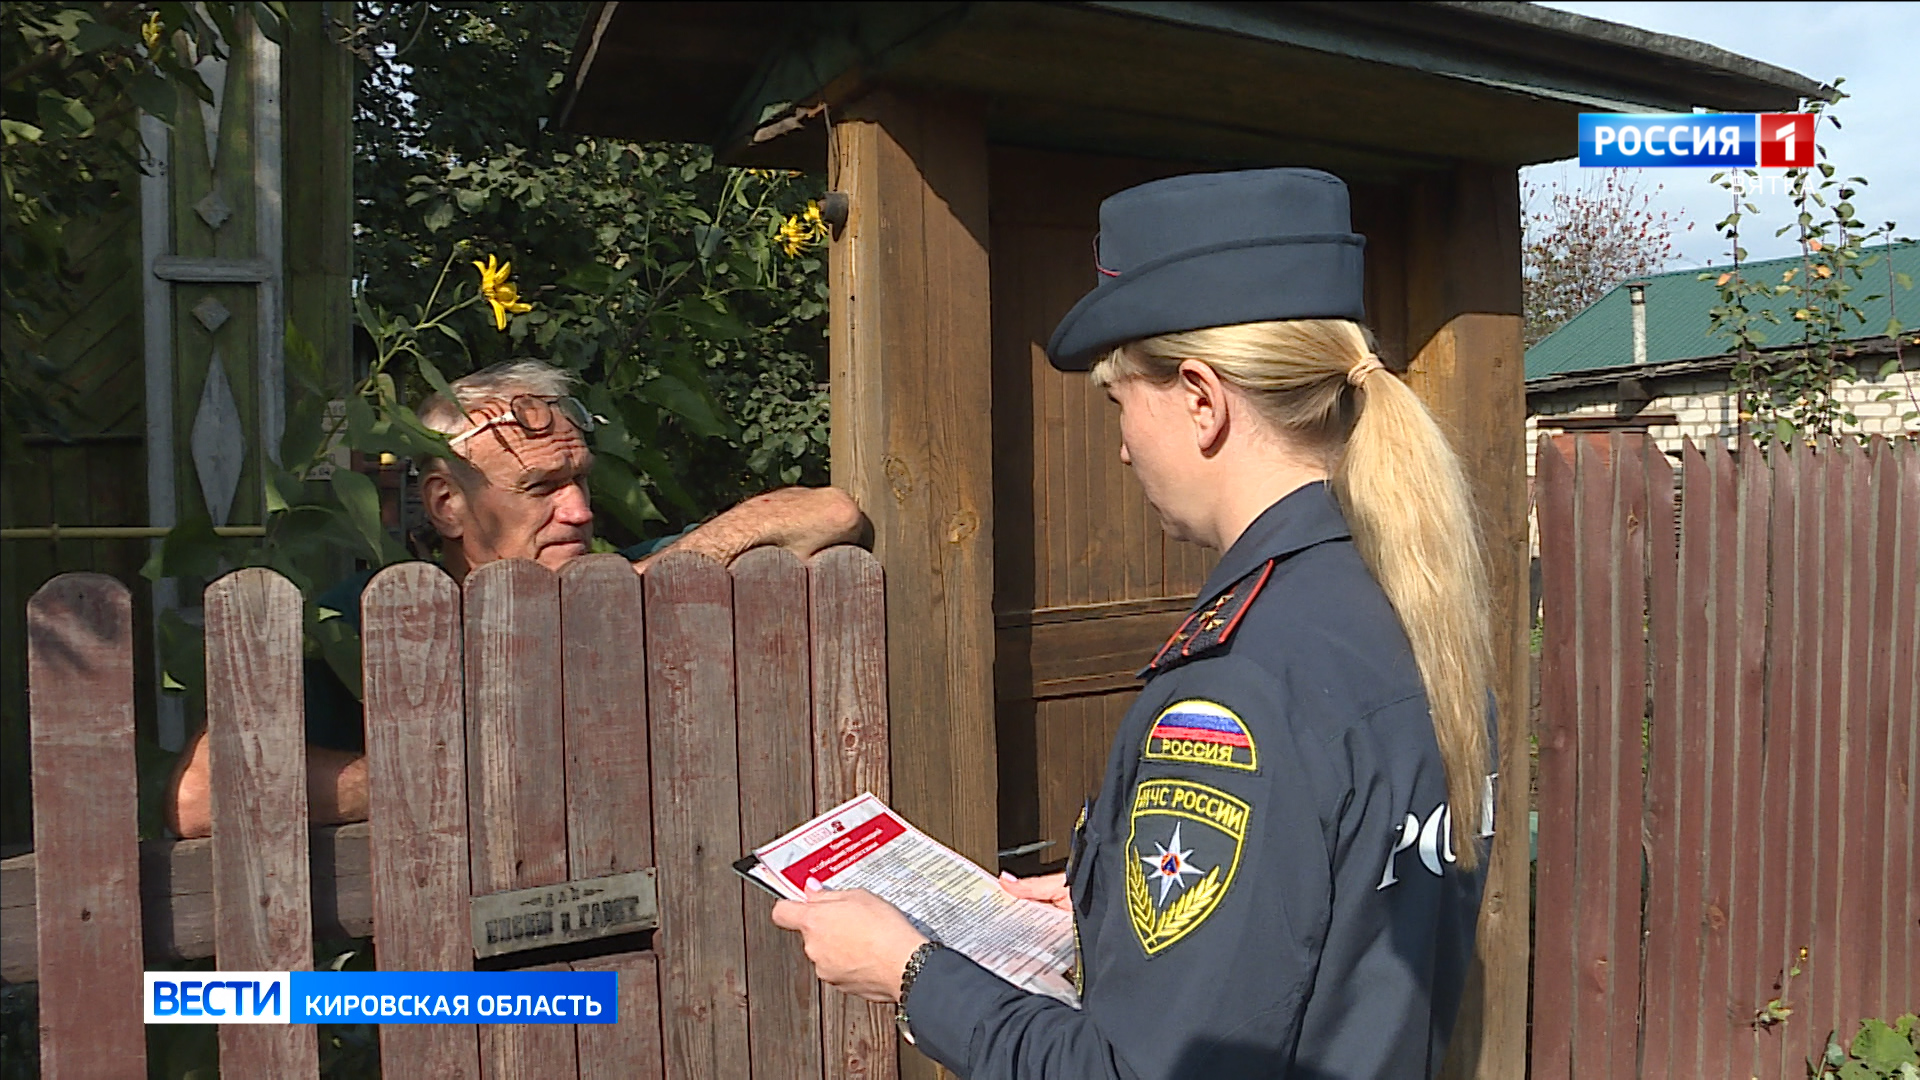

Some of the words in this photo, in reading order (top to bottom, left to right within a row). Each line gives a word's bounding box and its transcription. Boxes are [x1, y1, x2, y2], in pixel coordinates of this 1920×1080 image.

[1161, 738, 1233, 762] РОССИЯ
[1138, 787, 1170, 808] МЧС
[1172, 787, 1244, 831] РОССИИ
